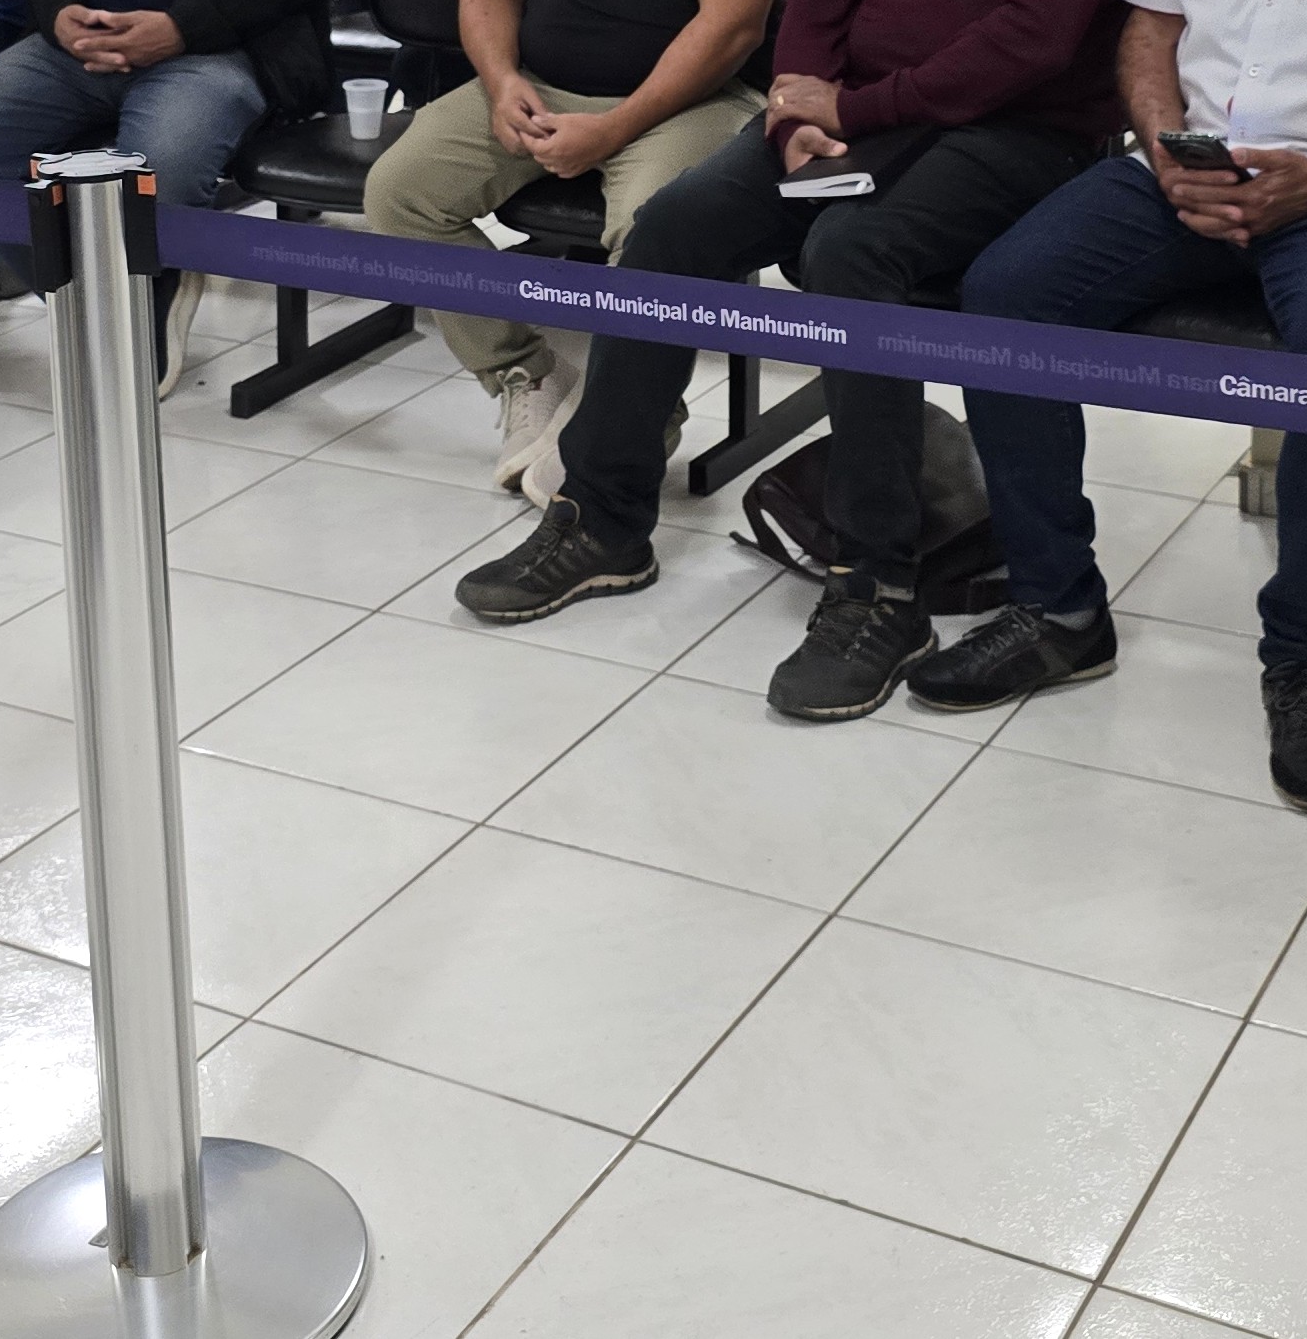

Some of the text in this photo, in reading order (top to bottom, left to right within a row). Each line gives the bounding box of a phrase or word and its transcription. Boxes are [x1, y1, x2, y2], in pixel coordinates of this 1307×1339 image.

[519, 279, 847, 345] Câmara Municipal de Manhumirim
